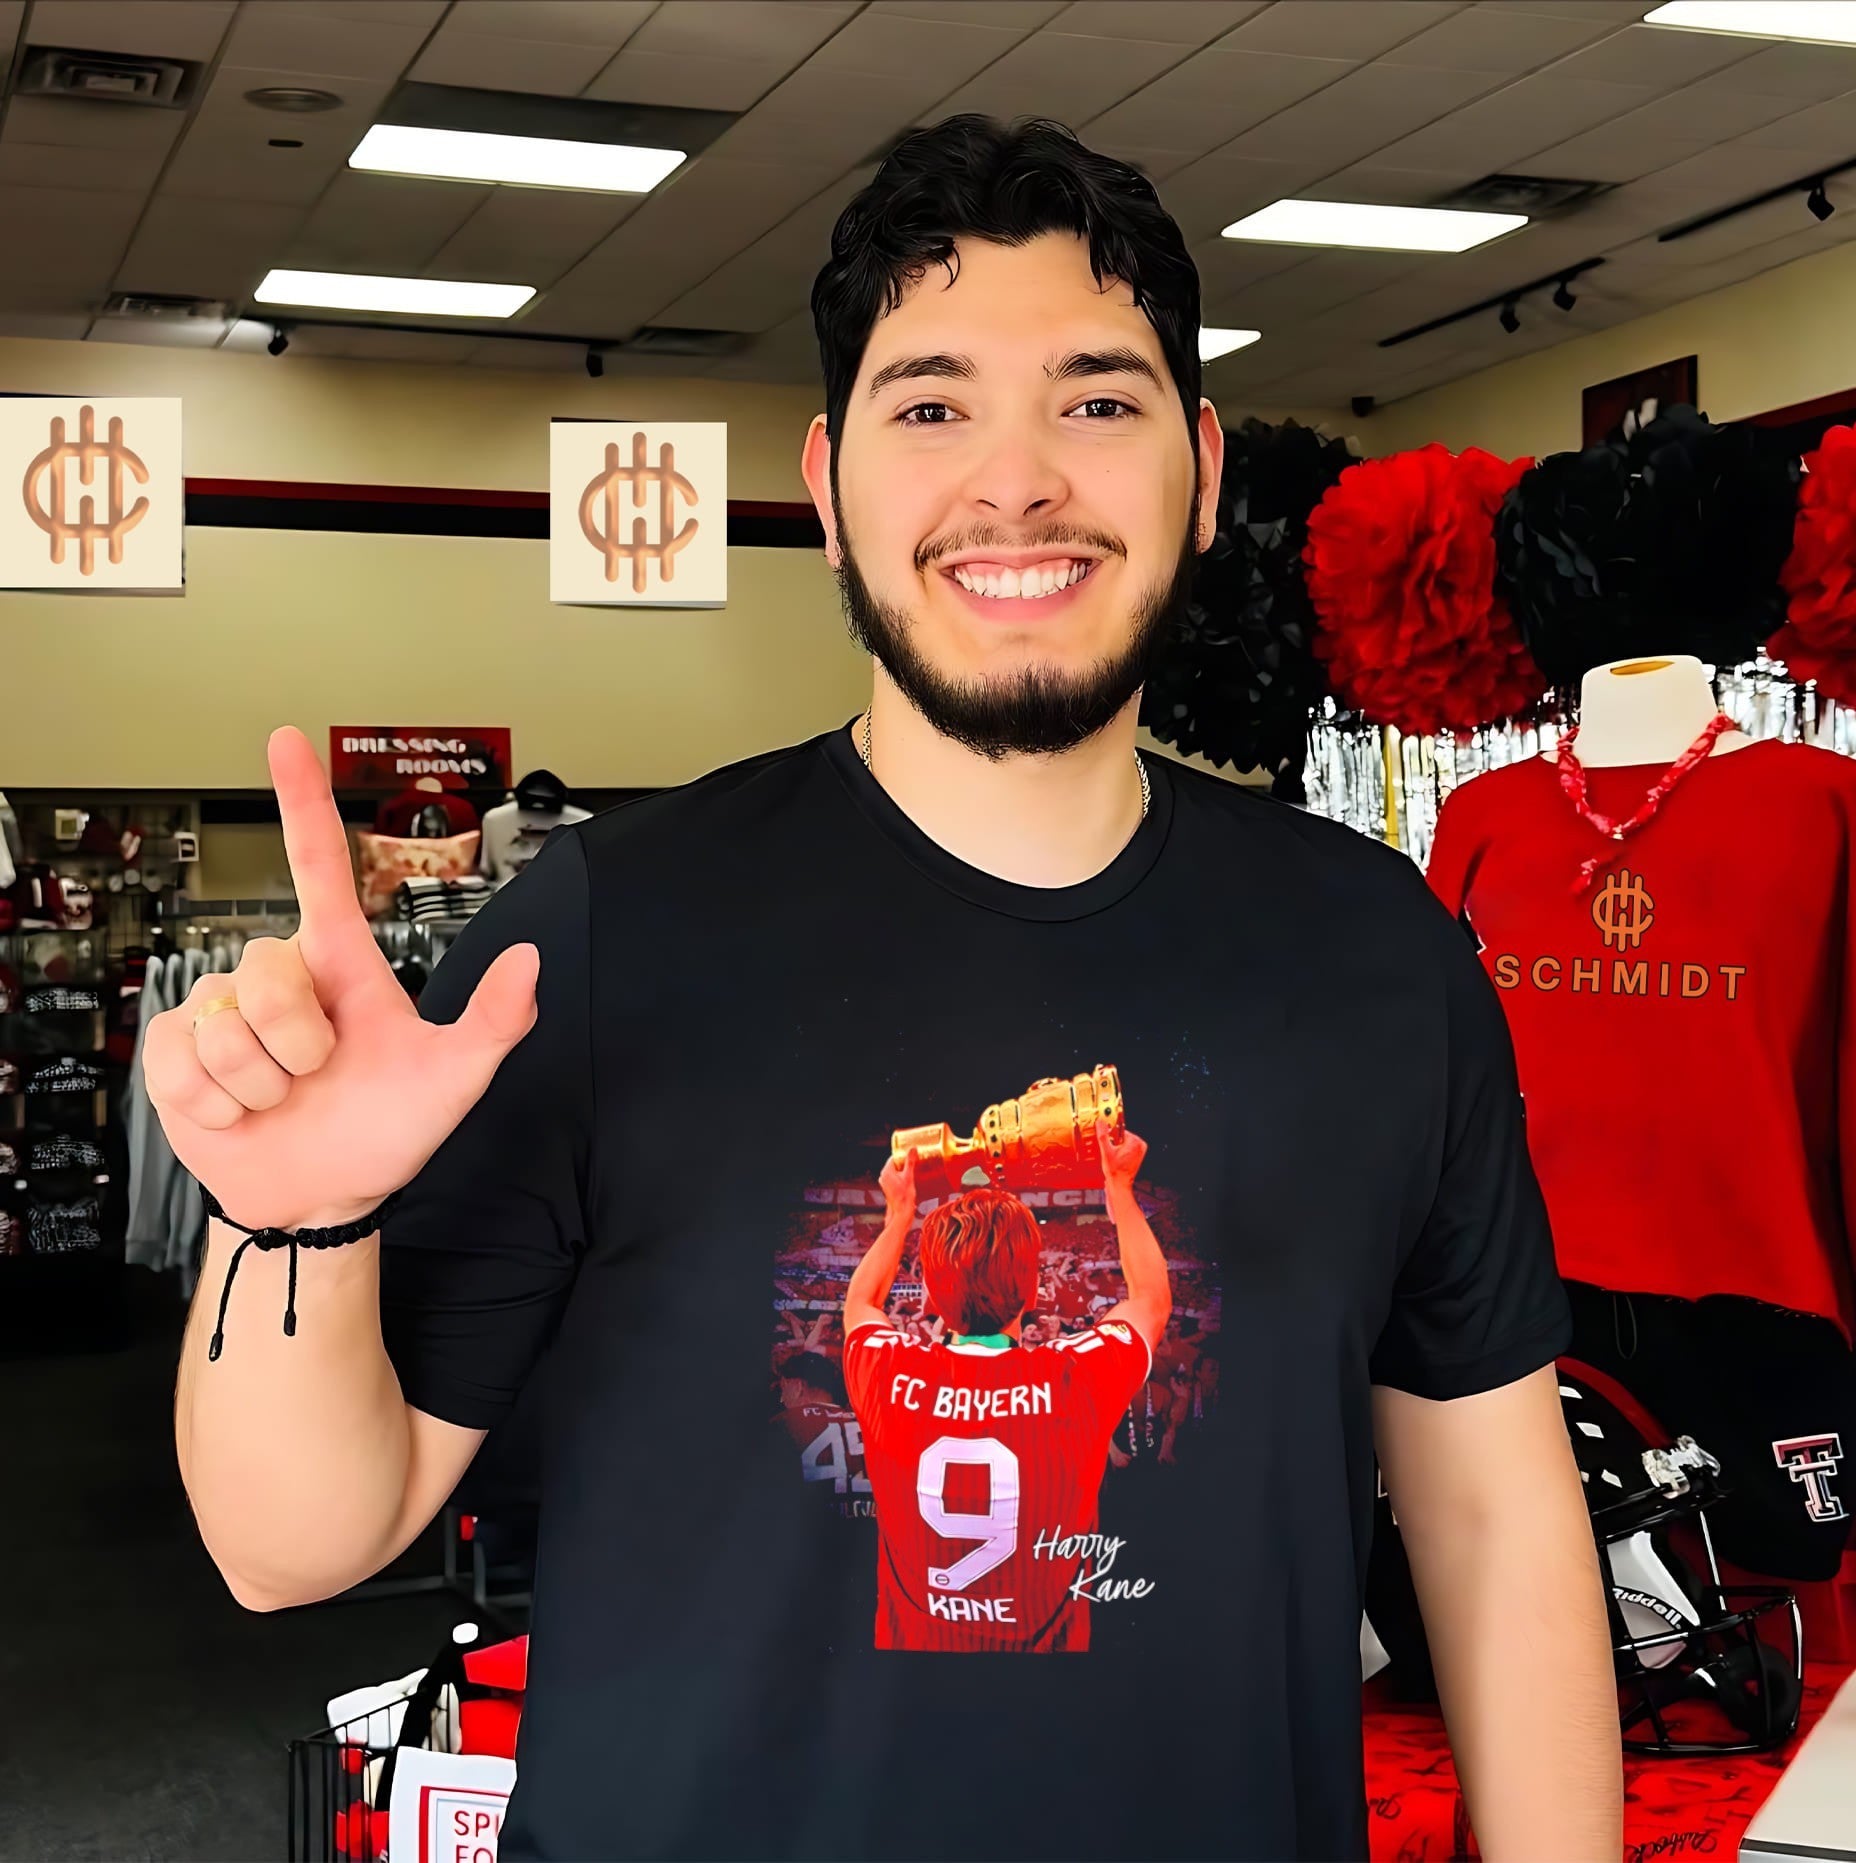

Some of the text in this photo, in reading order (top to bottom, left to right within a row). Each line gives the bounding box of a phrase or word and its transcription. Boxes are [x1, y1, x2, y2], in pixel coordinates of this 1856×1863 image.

[342, 737, 467, 754] DRESSING
[396, 758, 487, 774] ROOMS
[1494, 954, 1747, 1000] SCHMIDT
[891, 1373, 1053, 1421] FC BAYERN
[917, 1436, 1019, 1592] 9
[1033, 1524, 1127, 1577] Harry
[1069, 1568, 1155, 1604] Kane
[927, 1593, 1017, 1623] KANE
